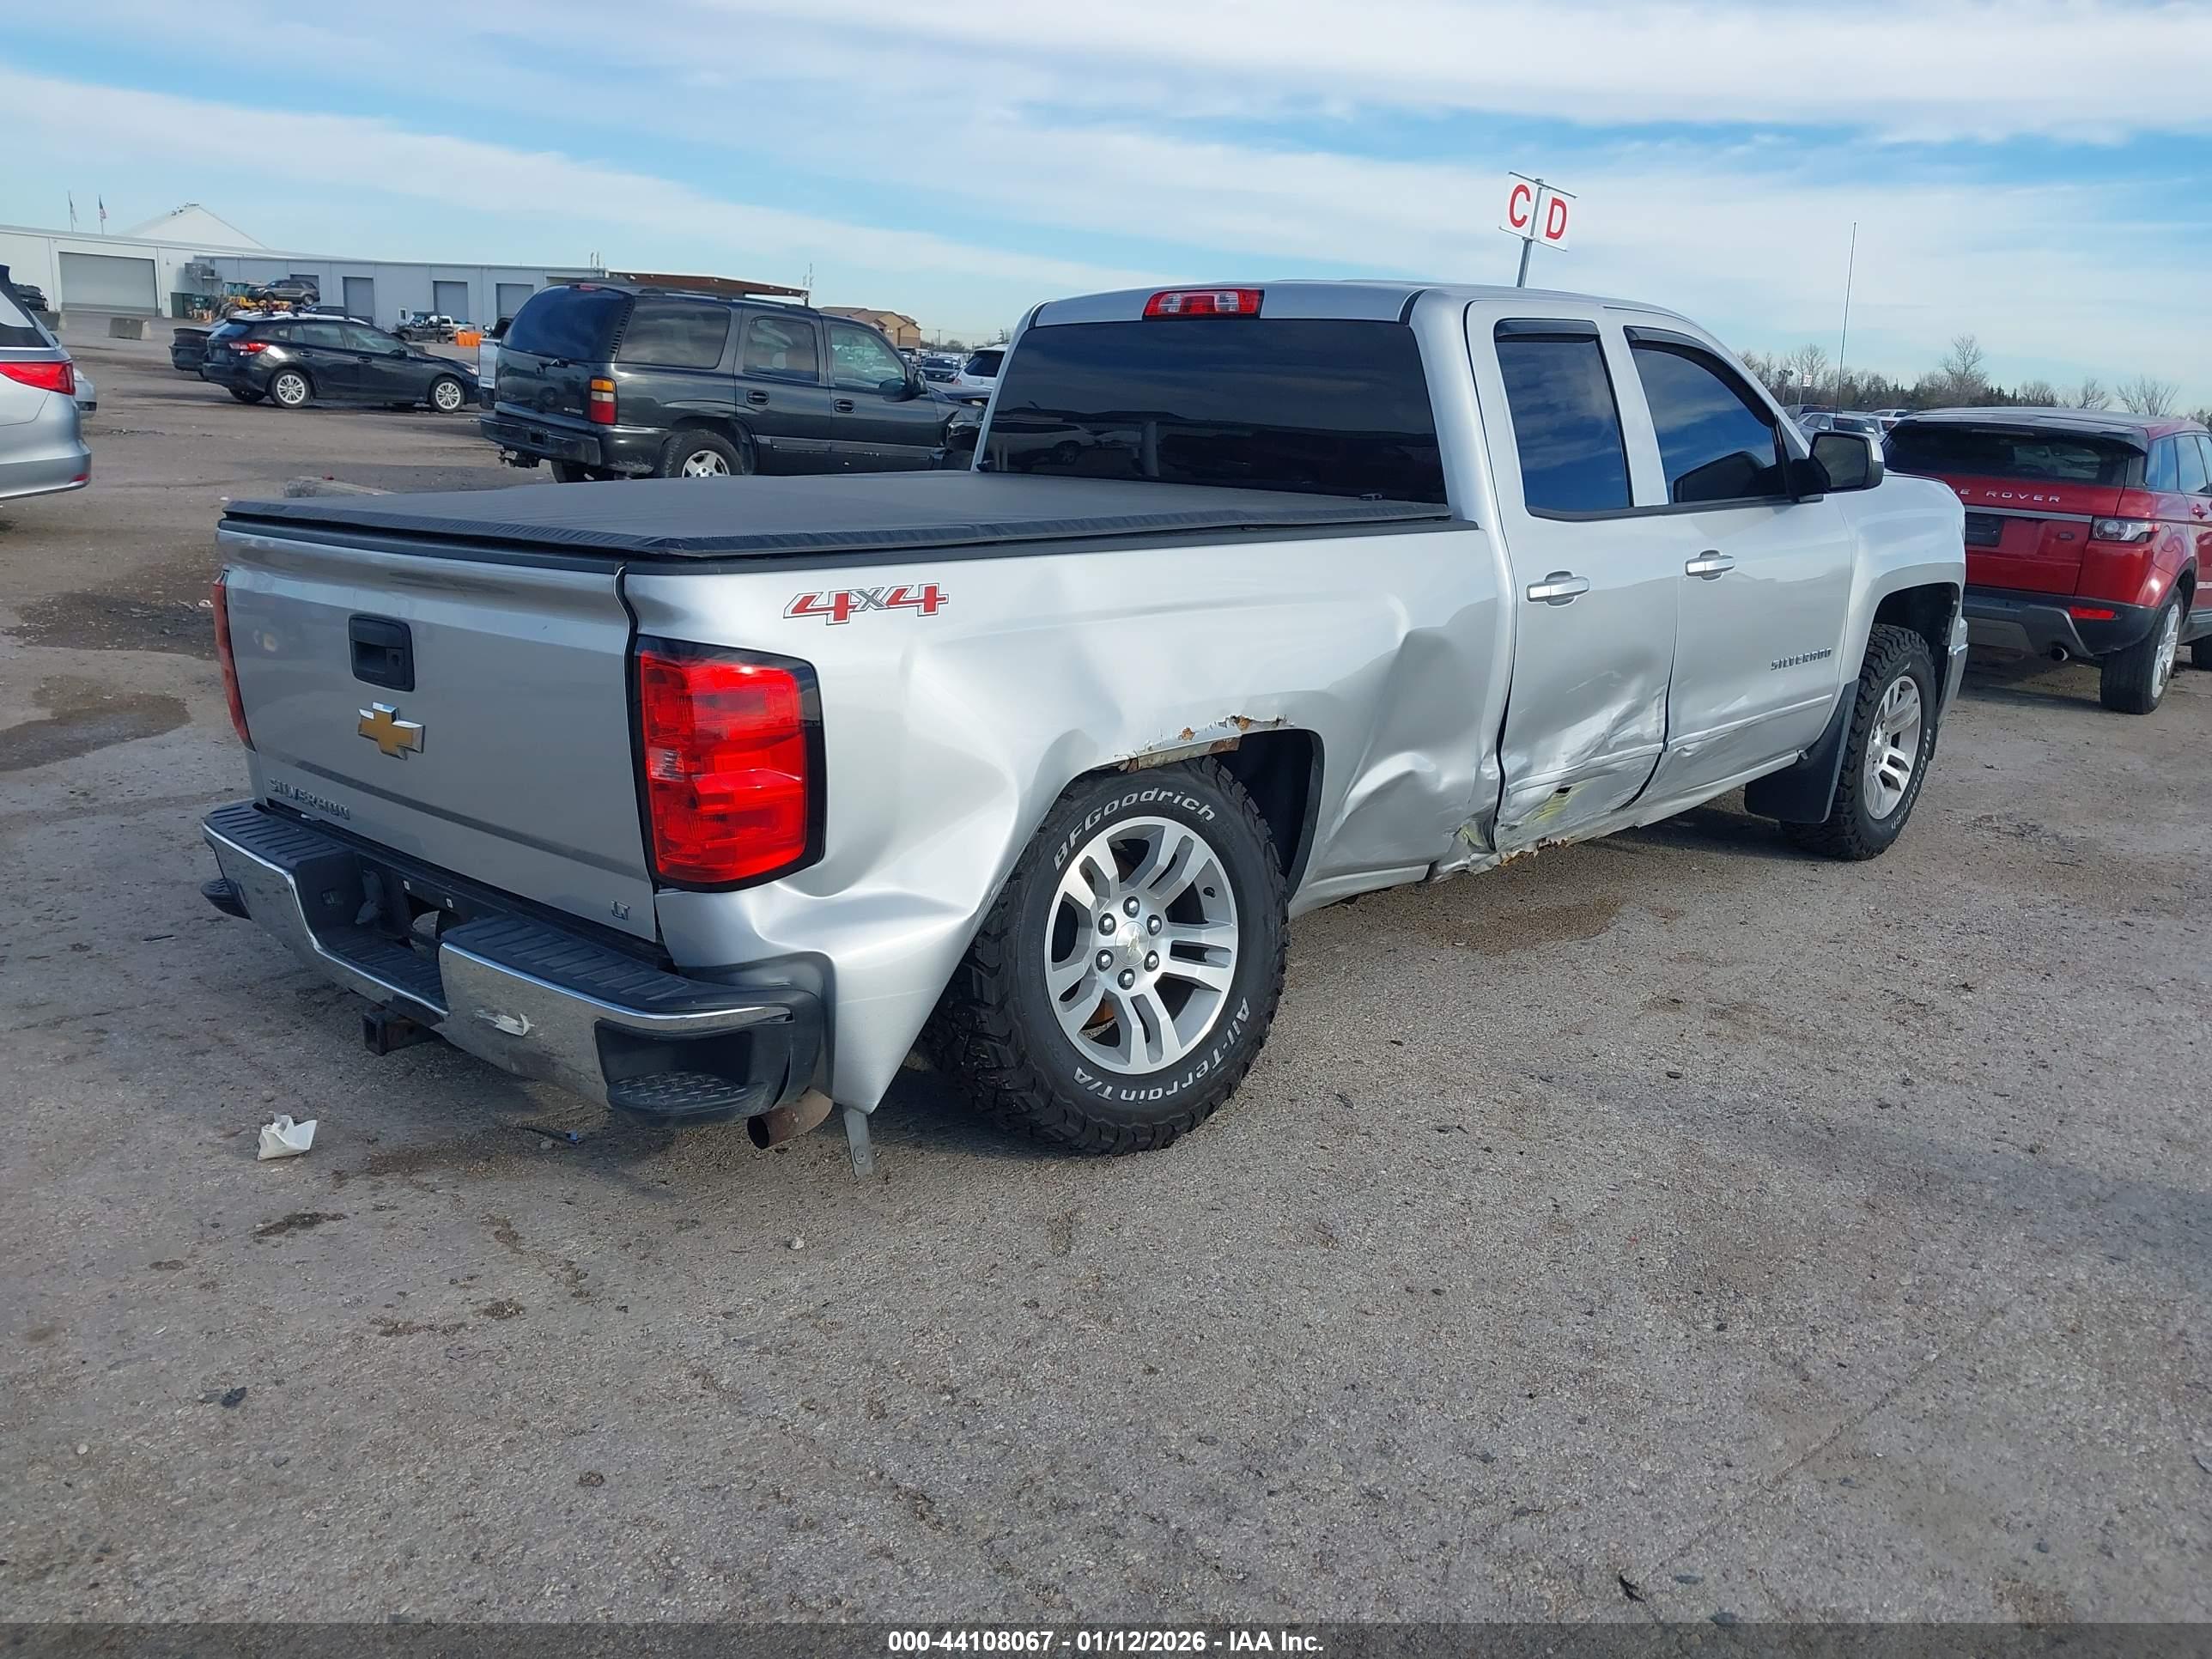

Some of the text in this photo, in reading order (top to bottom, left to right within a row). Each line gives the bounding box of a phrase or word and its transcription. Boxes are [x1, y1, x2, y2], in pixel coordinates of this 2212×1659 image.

[1510, 184, 1567, 240] C D
[1985, 490, 2061, 502] ROVER
[1771, 647, 1832, 672] SILVERADO
[1054, 787, 1216, 872] BFGoodrich
[611, 900, 630, 921] LT
[1073, 996, 1251, 1104] All-Terrain T/A
